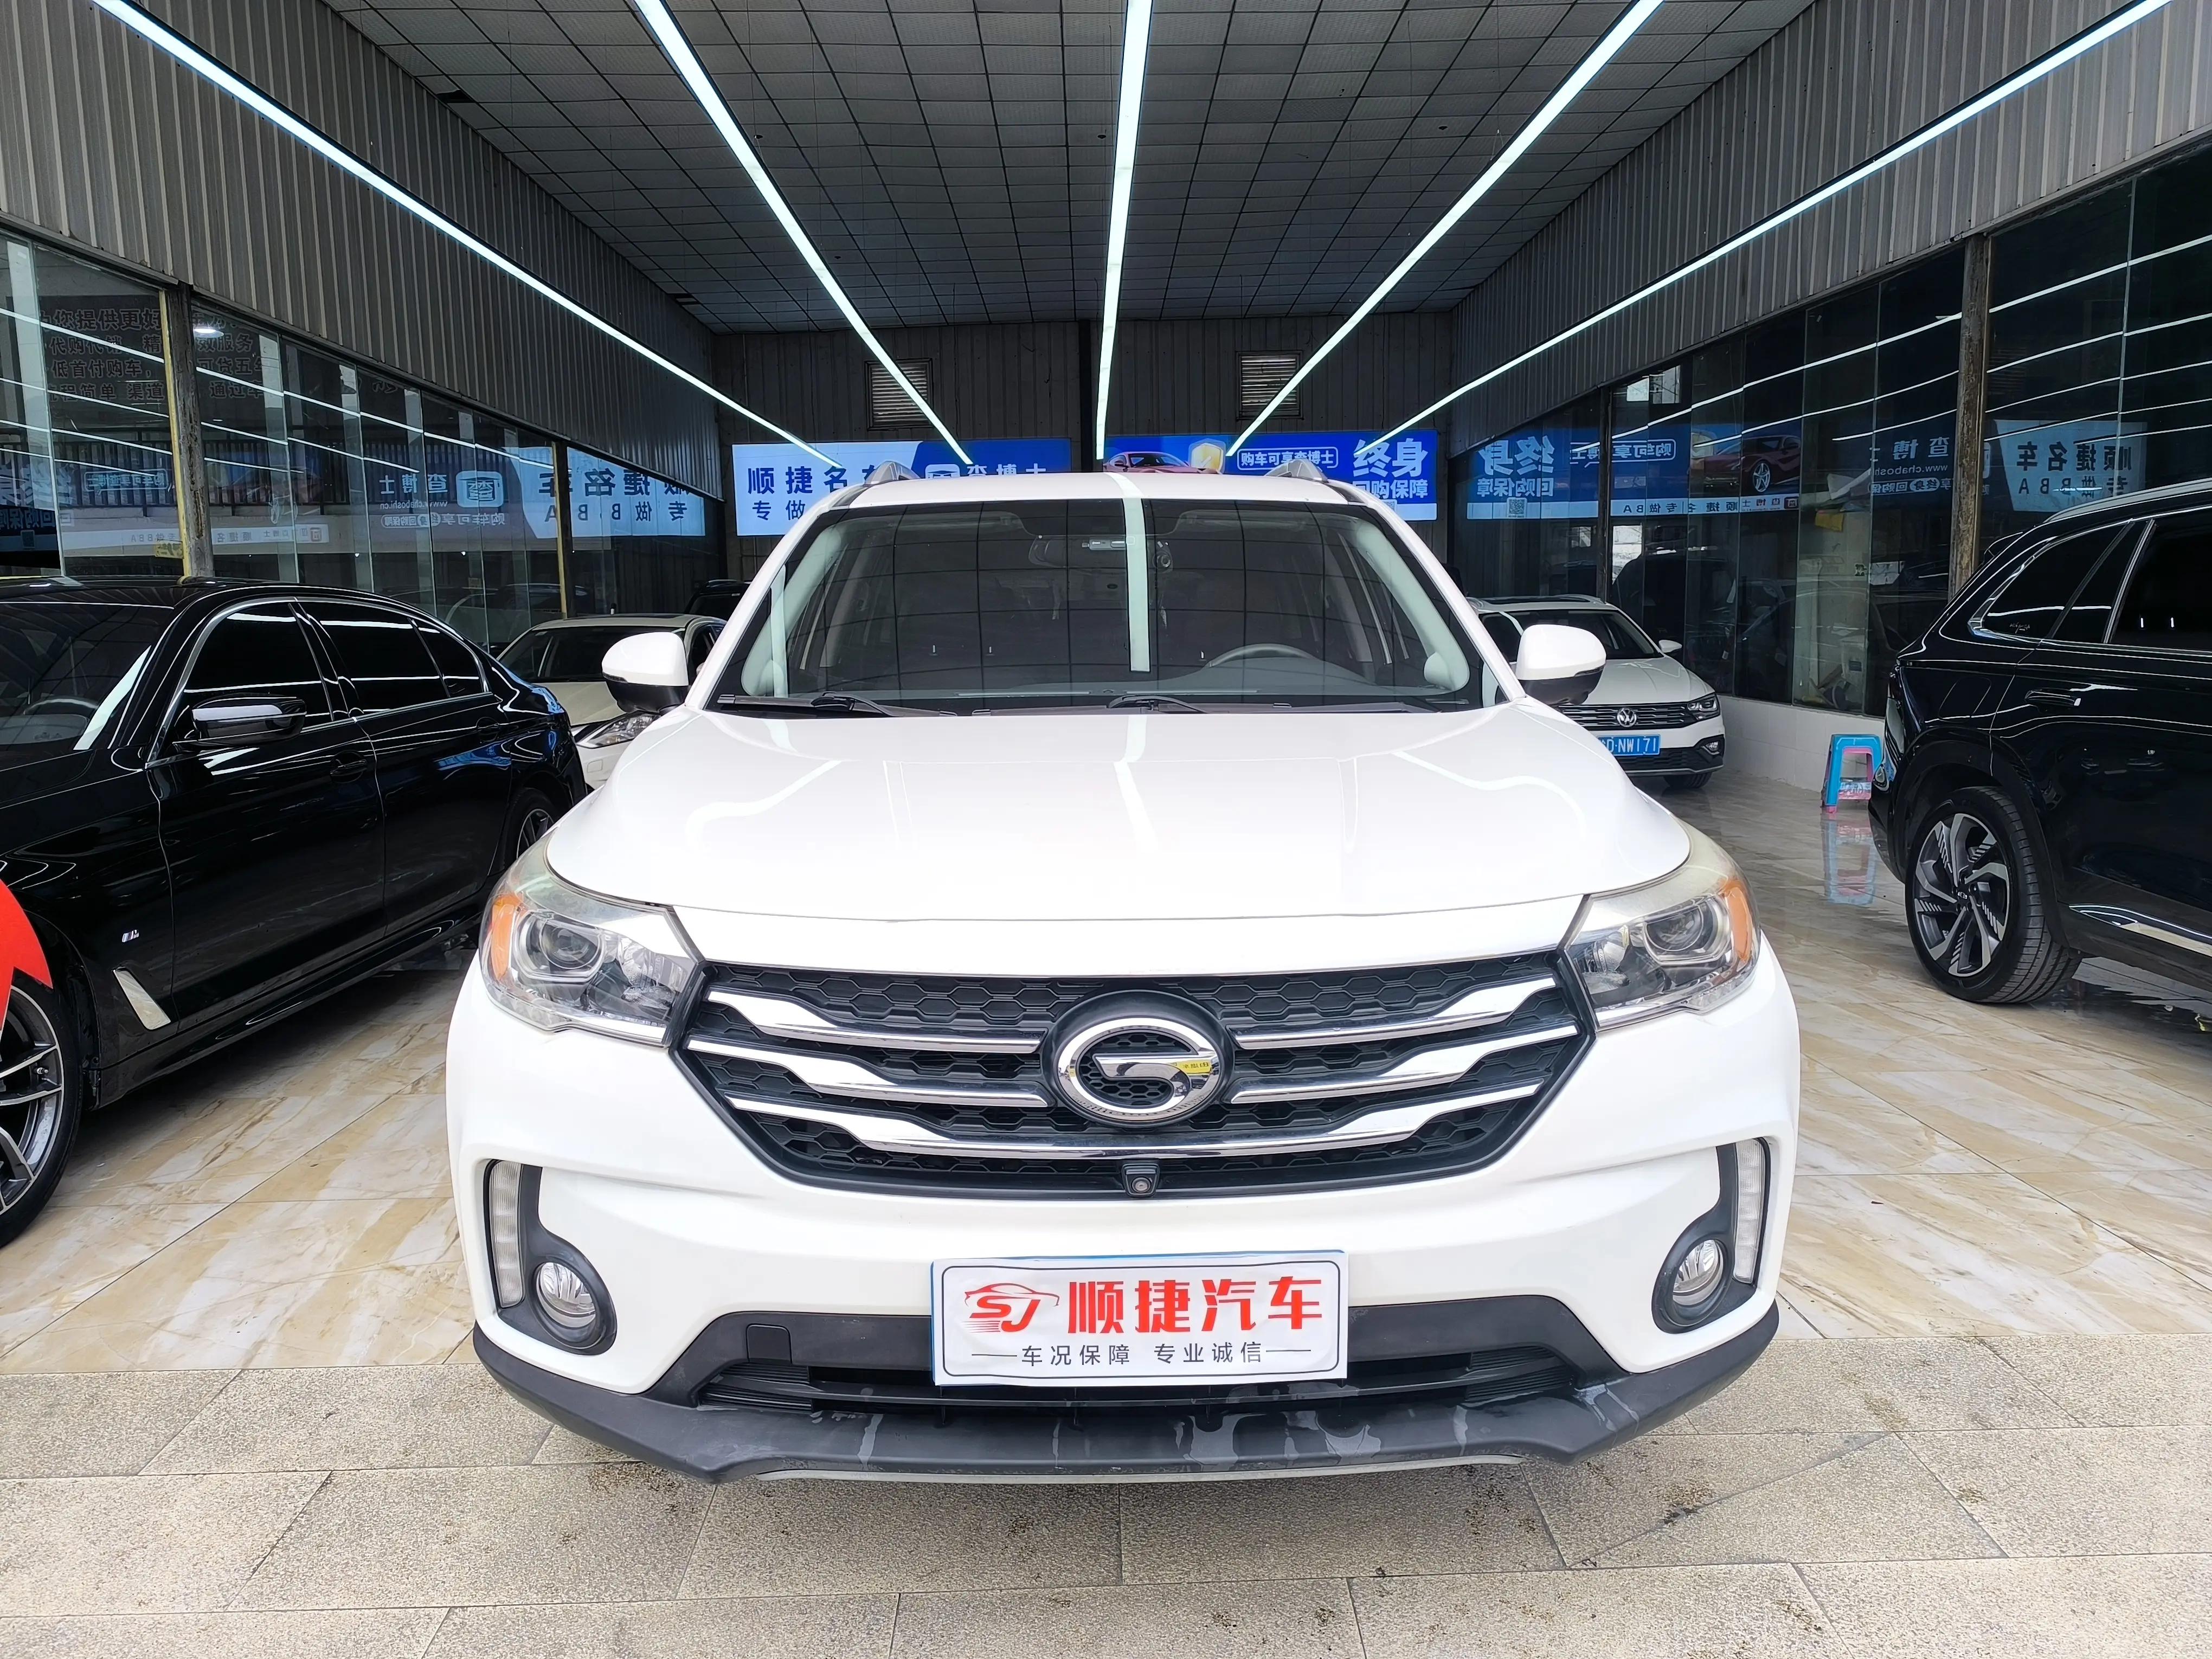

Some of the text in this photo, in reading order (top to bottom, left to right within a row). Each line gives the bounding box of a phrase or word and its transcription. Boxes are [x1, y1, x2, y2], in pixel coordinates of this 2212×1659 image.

[1353, 438, 1429, 478] 终身
[748, 464, 875, 494] 顺捷名
[1067, 1276, 1323, 1334] 顺捷汽车
[1021, 1341, 1262, 1366] 车况保障 专业诚信
